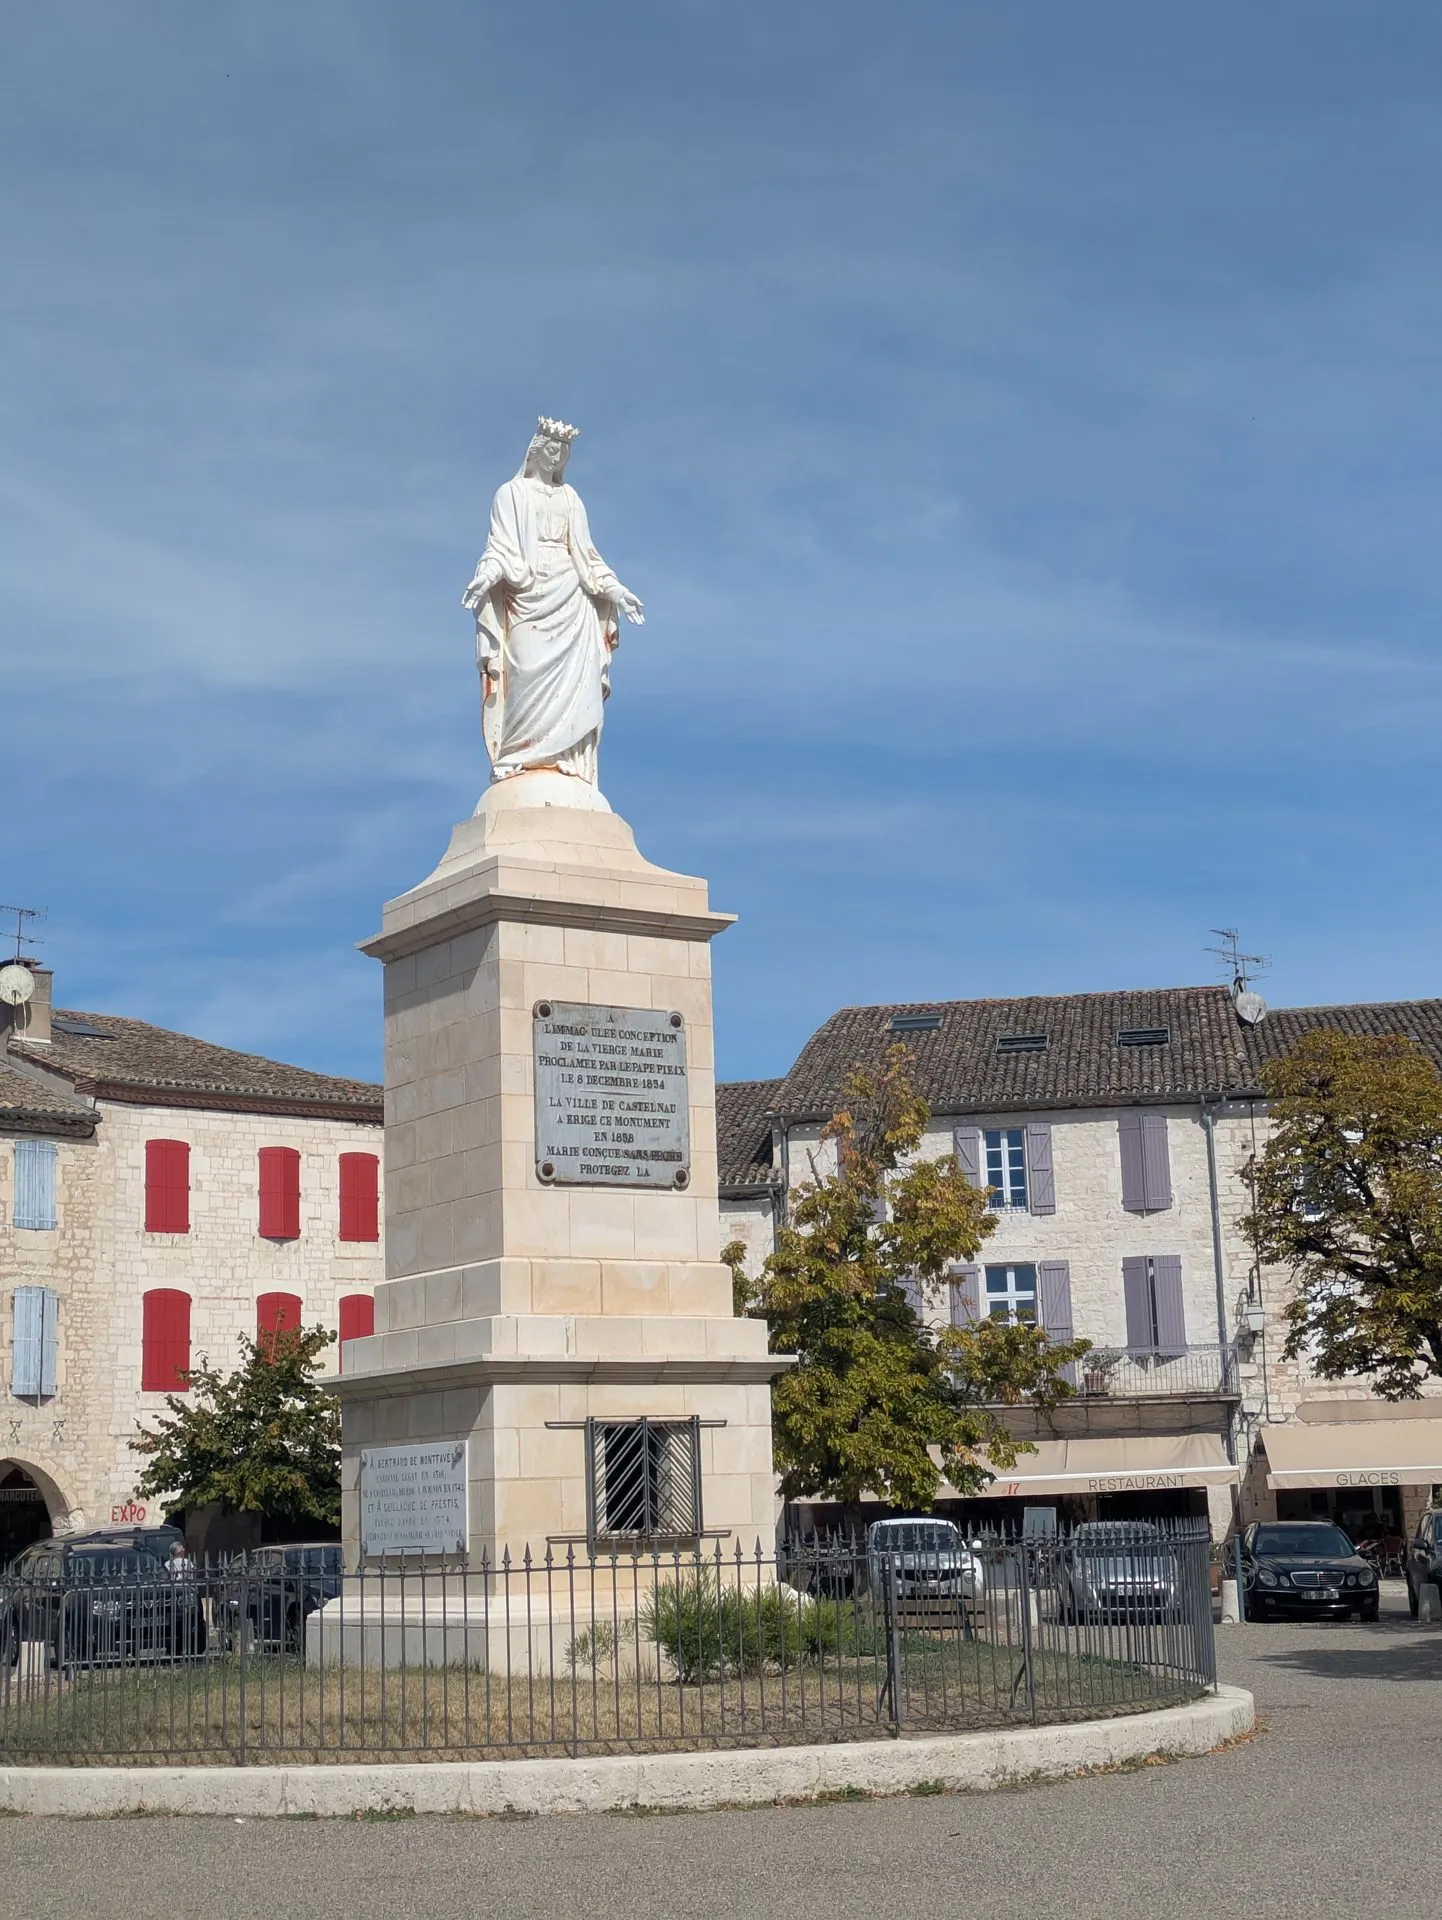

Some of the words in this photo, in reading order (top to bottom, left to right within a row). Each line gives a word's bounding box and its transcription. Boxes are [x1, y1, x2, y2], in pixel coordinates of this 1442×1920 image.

[608, 1014, 614, 1023] A
[619, 1029, 678, 1043] CONCEPTION
[560, 1041, 573, 1051] DE
[577, 1043, 589, 1053] LA
[592, 1043, 627, 1056] VIERGE
[631, 1047, 664, 1058] MARIE
[538, 1055, 597, 1069] PROCLAMEE
[599, 1060, 617, 1071] PAR
[632, 1063, 655, 1074] PAPE
[561, 1073, 574, 1084] LE
[577, 1074, 583, 1084] 8
[586, 1075, 639, 1088] DECEMBRE
[642, 1079, 665, 1090] 1854
[549, 1096, 562, 1107] LA
[565, 1097, 598, 1109] VILLE
[602, 1100, 615, 1110] DE
[619, 1100, 676, 1114] CASTELNAU
[566, 1114, 597, 1125] ERIGE
[600, 1116, 612, 1127] CE
[614, 1116, 671, 1129] MONUMENT
[593, 1131, 608, 1142] EN
[611, 1132, 635, 1144] 1858
[546, 1145, 580, 1157] MARIE
[582, 1147, 621, 1160] CONÇUE
[623, 1149, 649, 1161] SANS
[580, 1164, 630, 1176] PROTEGEZ
[637, 1166, 650, 1177] LA
[378, 1458, 408, 1469] BERTRAND
[410, 1456, 418, 1467] DE
[1088, 1474, 1187, 1491] RESTAURANT
[1336, 1472, 1399, 1486] GLACES
[1007, 1482, 1021, 1495] 17
[111, 1504, 146, 1522] EXPO
